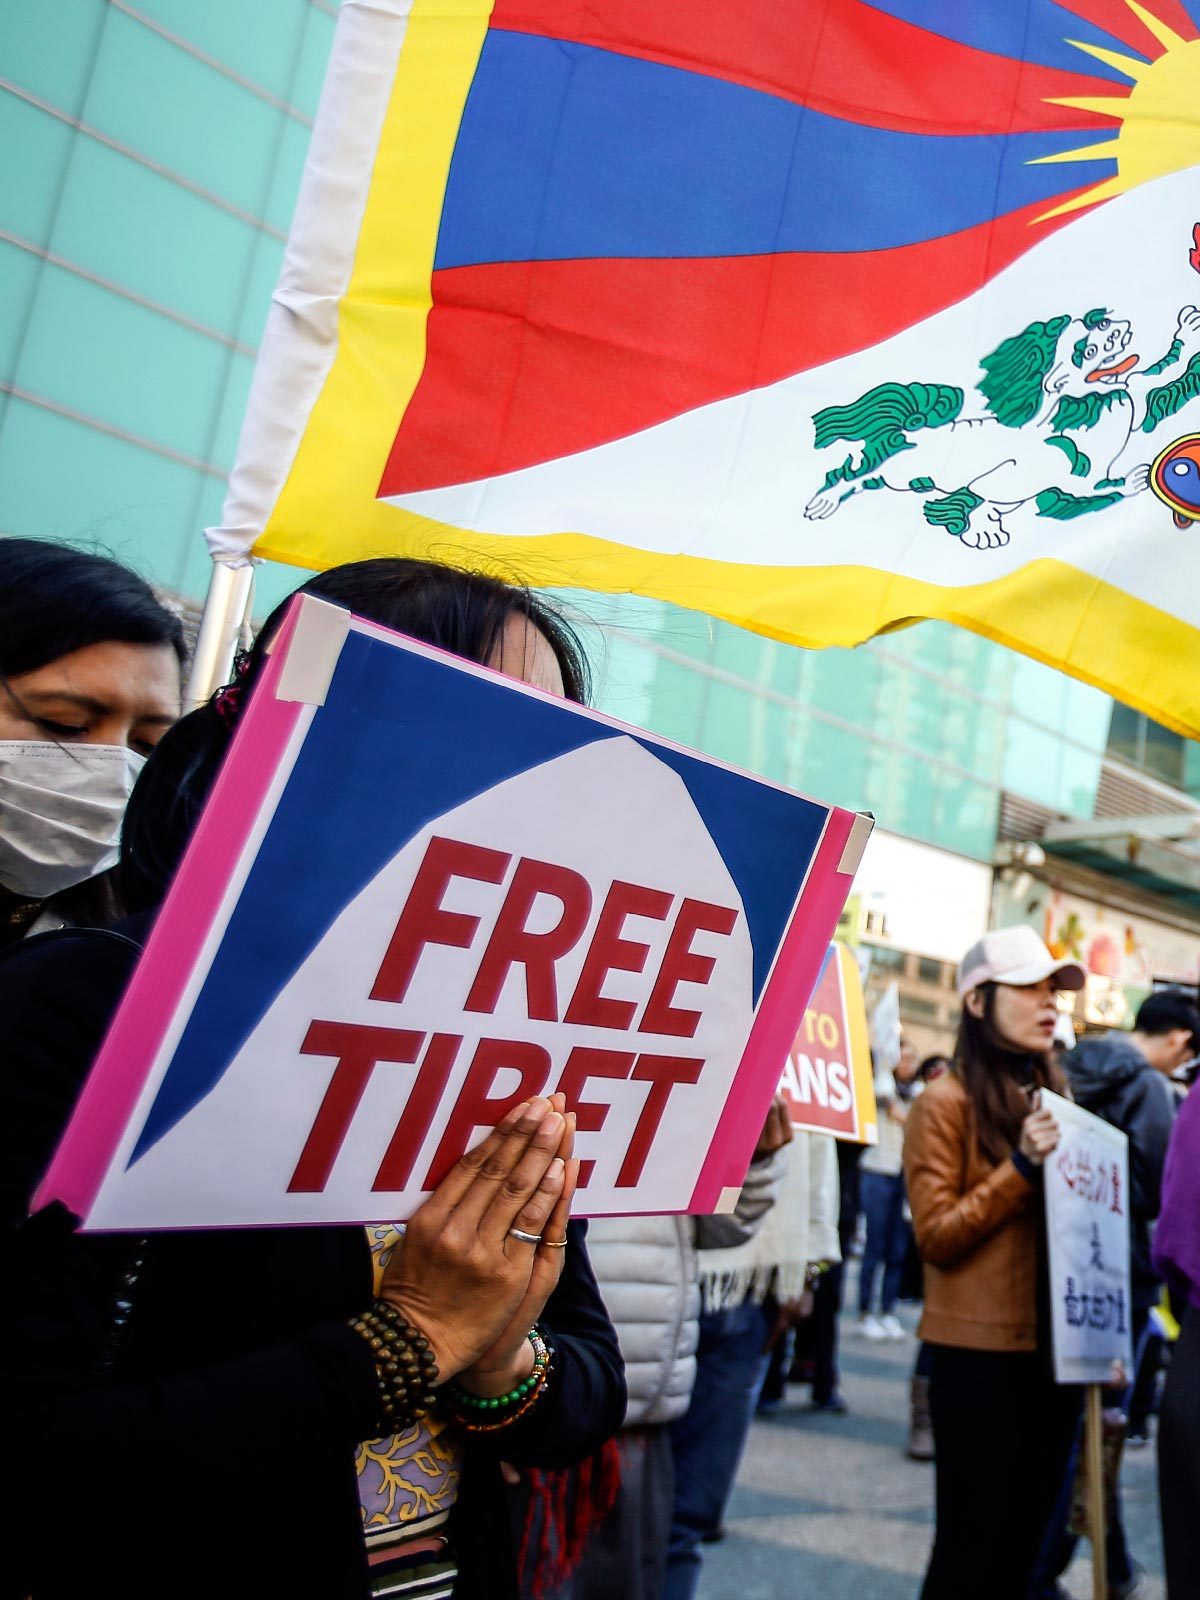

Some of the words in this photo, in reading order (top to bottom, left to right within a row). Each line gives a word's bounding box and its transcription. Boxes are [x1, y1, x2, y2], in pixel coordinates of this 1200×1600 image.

[368, 835, 739, 1038] FREE
[286, 1018, 706, 1193] TIBET
[804, 1011, 840, 1049] TO
